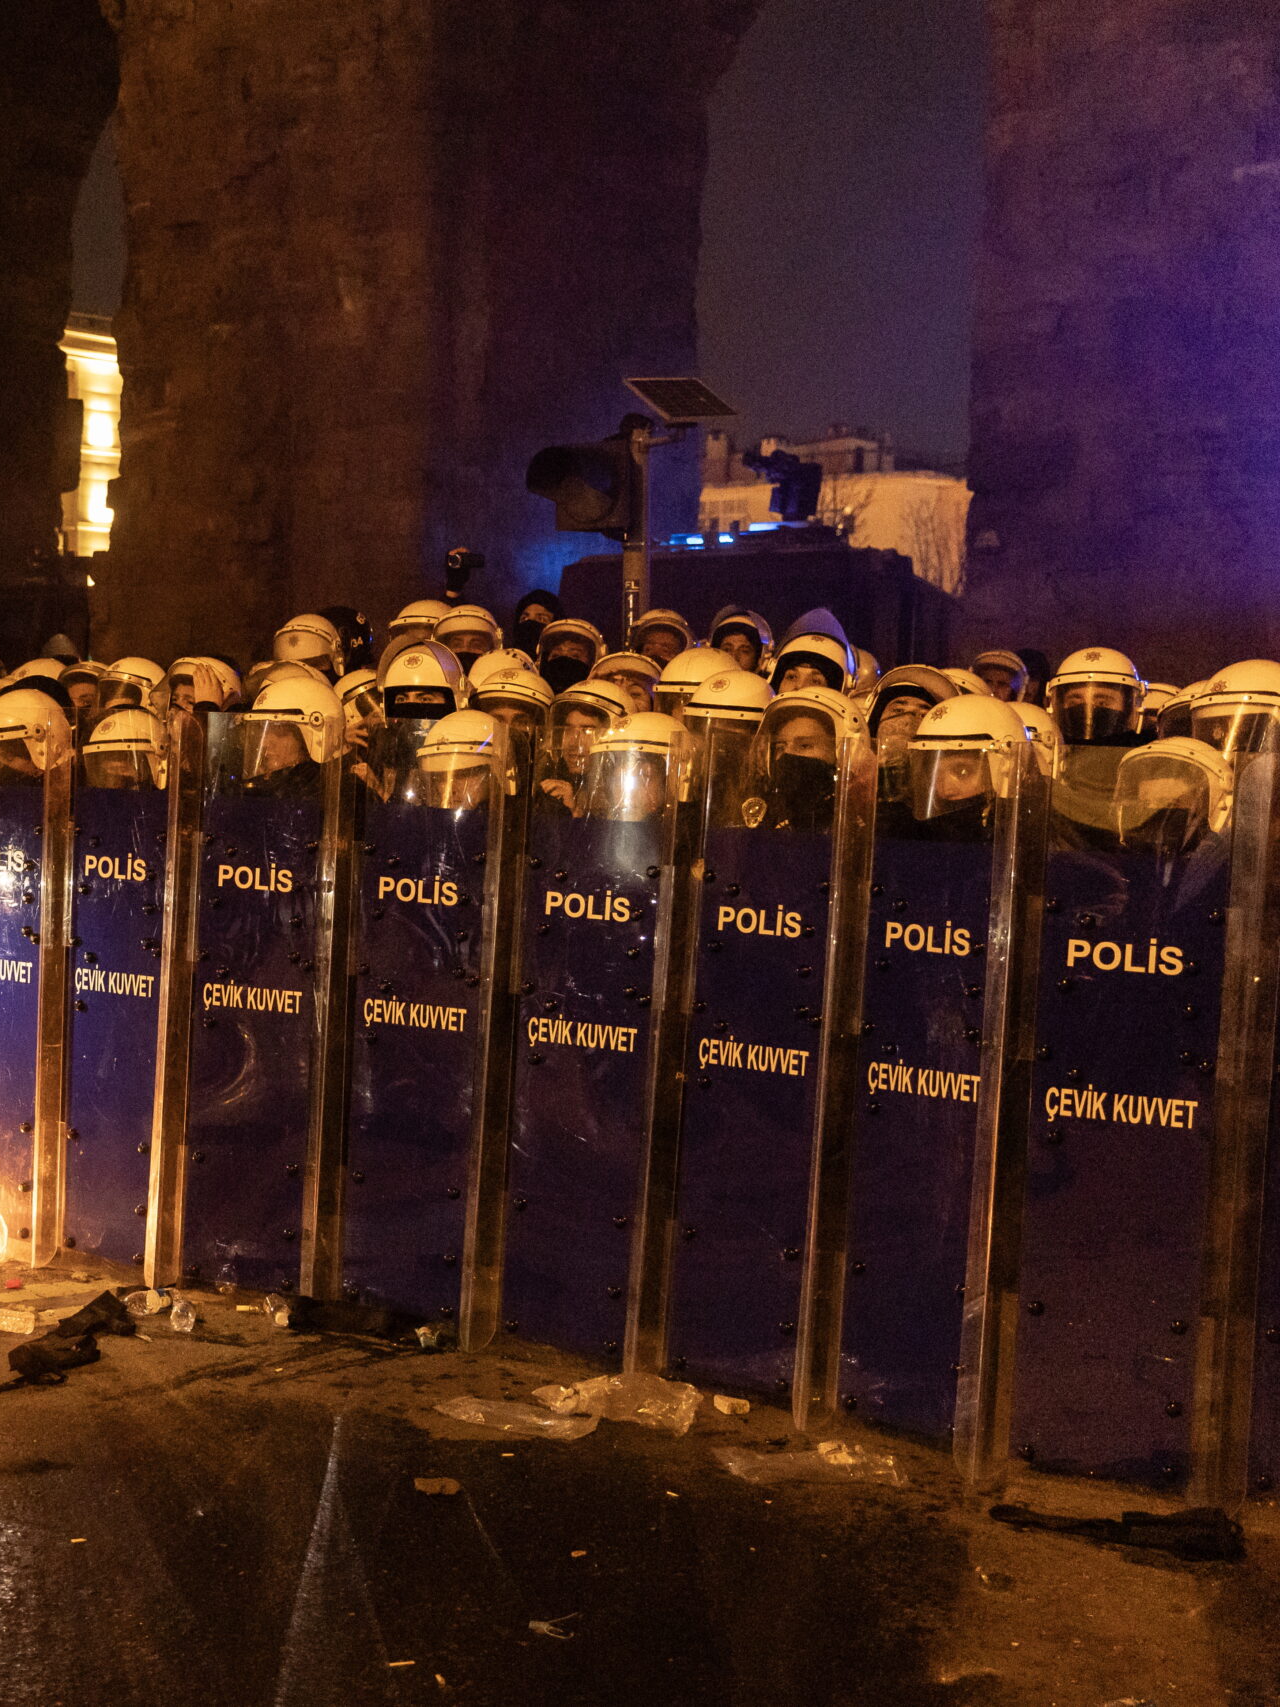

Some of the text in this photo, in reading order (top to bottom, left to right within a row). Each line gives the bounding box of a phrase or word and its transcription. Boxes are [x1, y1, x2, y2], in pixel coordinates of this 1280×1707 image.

[84, 853, 147, 883] POLİS
[217, 862, 293, 894] POLİS
[378, 872, 459, 907] POLİS
[544, 888, 631, 923] POLİS
[717, 904, 802, 939] POLİS
[884, 920, 971, 957] POLİS
[1066, 937, 1184, 976] POLİS
[74, 963, 155, 998] ÇEVİK KUVVET
[202, 979, 303, 1015] ÇEVİK KUVVET
[363, 995, 468, 1033] ÇEVİK KUVVET
[527, 1013, 638, 1053] ÇEVİK KUVVET
[698, 1034, 810, 1077] ÇEVİK KUVVET
[867, 1058, 981, 1104] ÇEVİK KUVVET
[1044, 1083, 1199, 1130] ÇEVİK KUVVET
